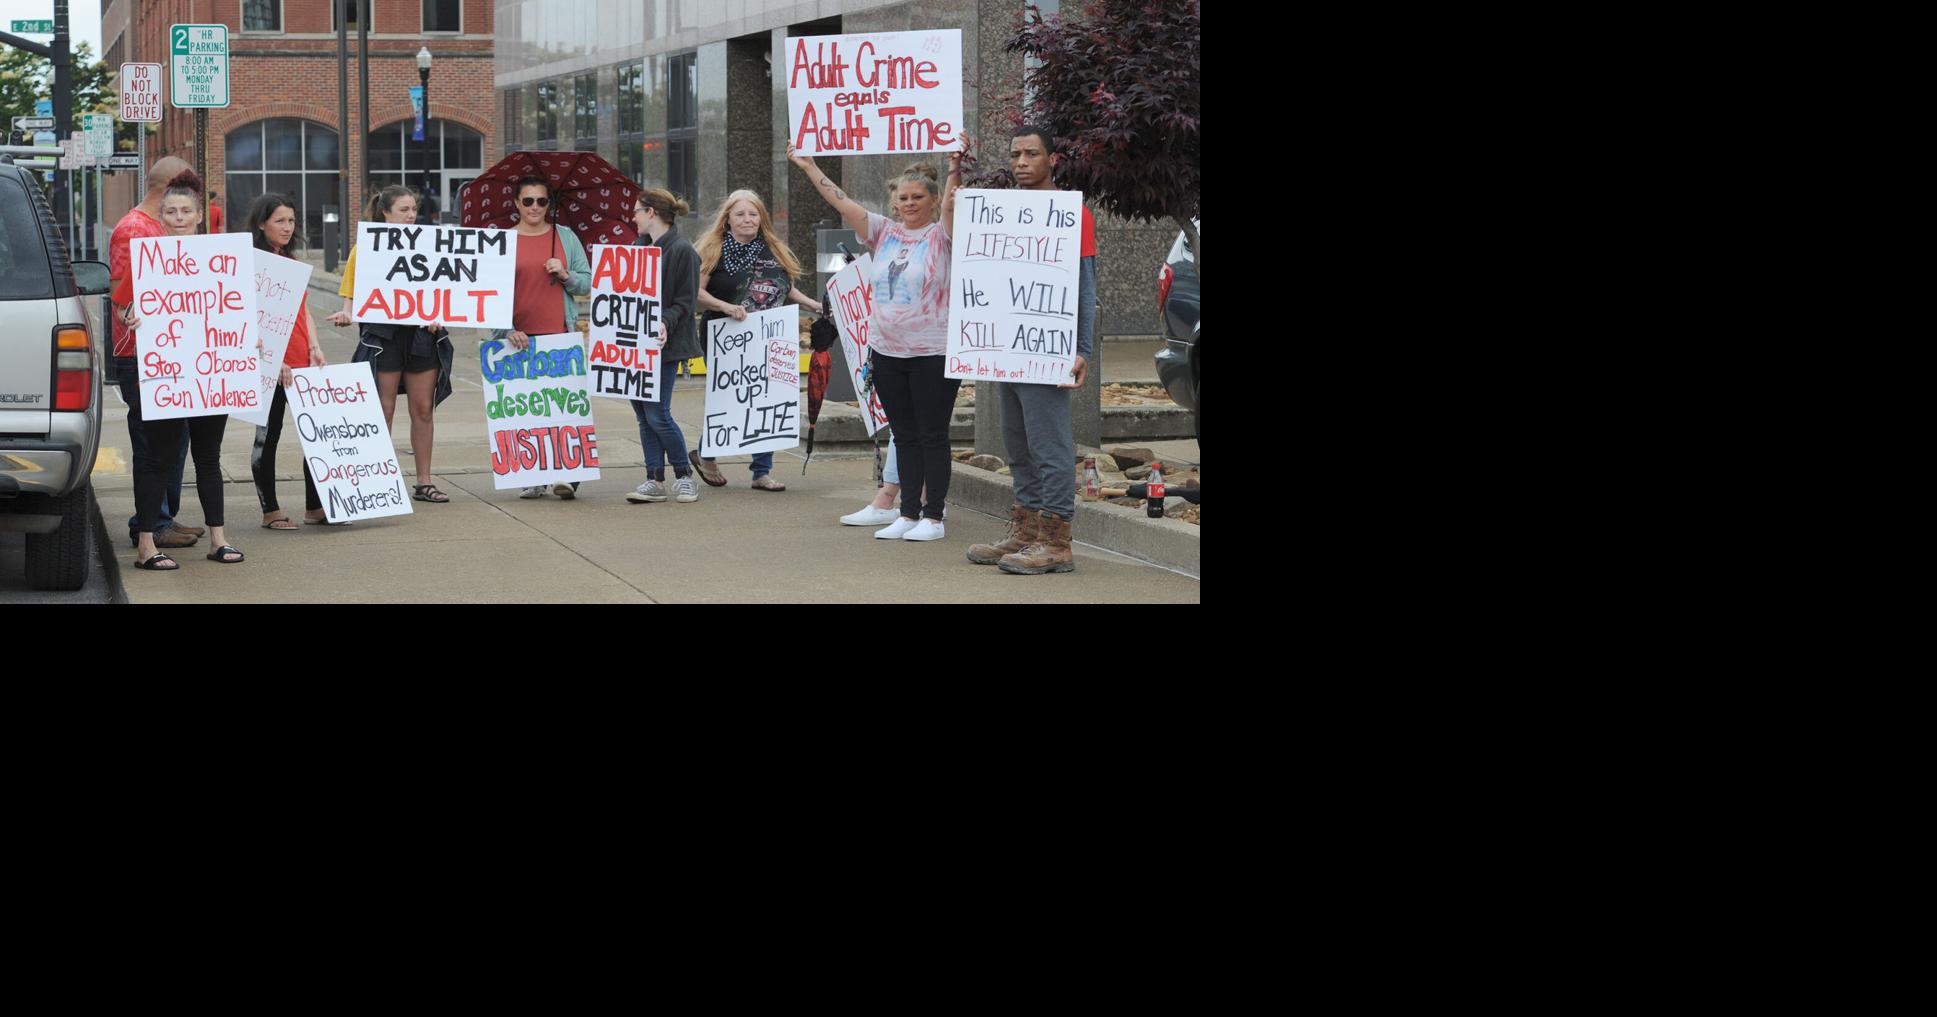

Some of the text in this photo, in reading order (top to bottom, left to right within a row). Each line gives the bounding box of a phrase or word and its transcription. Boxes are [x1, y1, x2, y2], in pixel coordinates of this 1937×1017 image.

[22, 21, 39, 31] 2nd
[175, 29, 187, 49] 2
[201, 30, 213, 40] HR
[186, 56, 214, 64] 8:00 AM
[190, 42, 225, 52] PARKING
[134, 66, 148, 78] DO
[181, 66, 219, 75] TO 5:00 PM
[791, 38, 940, 89] Adult Crime
[131, 80, 151, 92] NOT
[186, 75, 214, 84] MONDAY
[191, 85, 210, 93] THRU
[124, 93, 158, 105] BLOCK
[126, 106, 157, 118] DRIVE
[188, 95, 215, 103] FRIDAY
[834, 89, 891, 111] equals
[796, 101, 956, 152] Adult Time
[965, 195, 1076, 228] This is his
[367, 227, 506, 255] TRY HIM
[965, 232, 1067, 263] LIFESTYLE
[138, 240, 238, 280] Make an
[592, 246, 660, 297] ADULT
[140, 281, 244, 321] example
[357, 288, 498, 323] ADULT
[829, 265, 873, 327] Thank
[962, 278, 1074, 316] He WILL
[591, 294, 660, 338] CRIME
[156, 319, 247, 349] of him!
[713, 316, 784, 357] Keep him
[847, 321, 869, 368] Yo
[960, 320, 1073, 355] KILL AGAIN
[143, 352, 182, 383] Stop
[590, 340, 659, 371] ADULT
[712, 345, 768, 392] locked
[977, 357, 990, 376] let
[993, 361, 1006, 377] him
[1010, 368, 1024, 378] out
[591, 365, 654, 399] TIME
[771, 366, 798, 384] JUSTICE
[154, 385, 193, 409] Gun
[196, 379, 258, 409] Violence
[294, 375, 367, 407] Protect
[487, 385, 590, 420] deserves
[297, 413, 379, 443] Owensboro
[707, 401, 797, 447] For LIFE
[332, 441, 359, 457] from
[491, 425, 600, 475] JUSTICE
[309, 457, 398, 486] Dangerous
[328, 480, 403, 518] Murderers!
